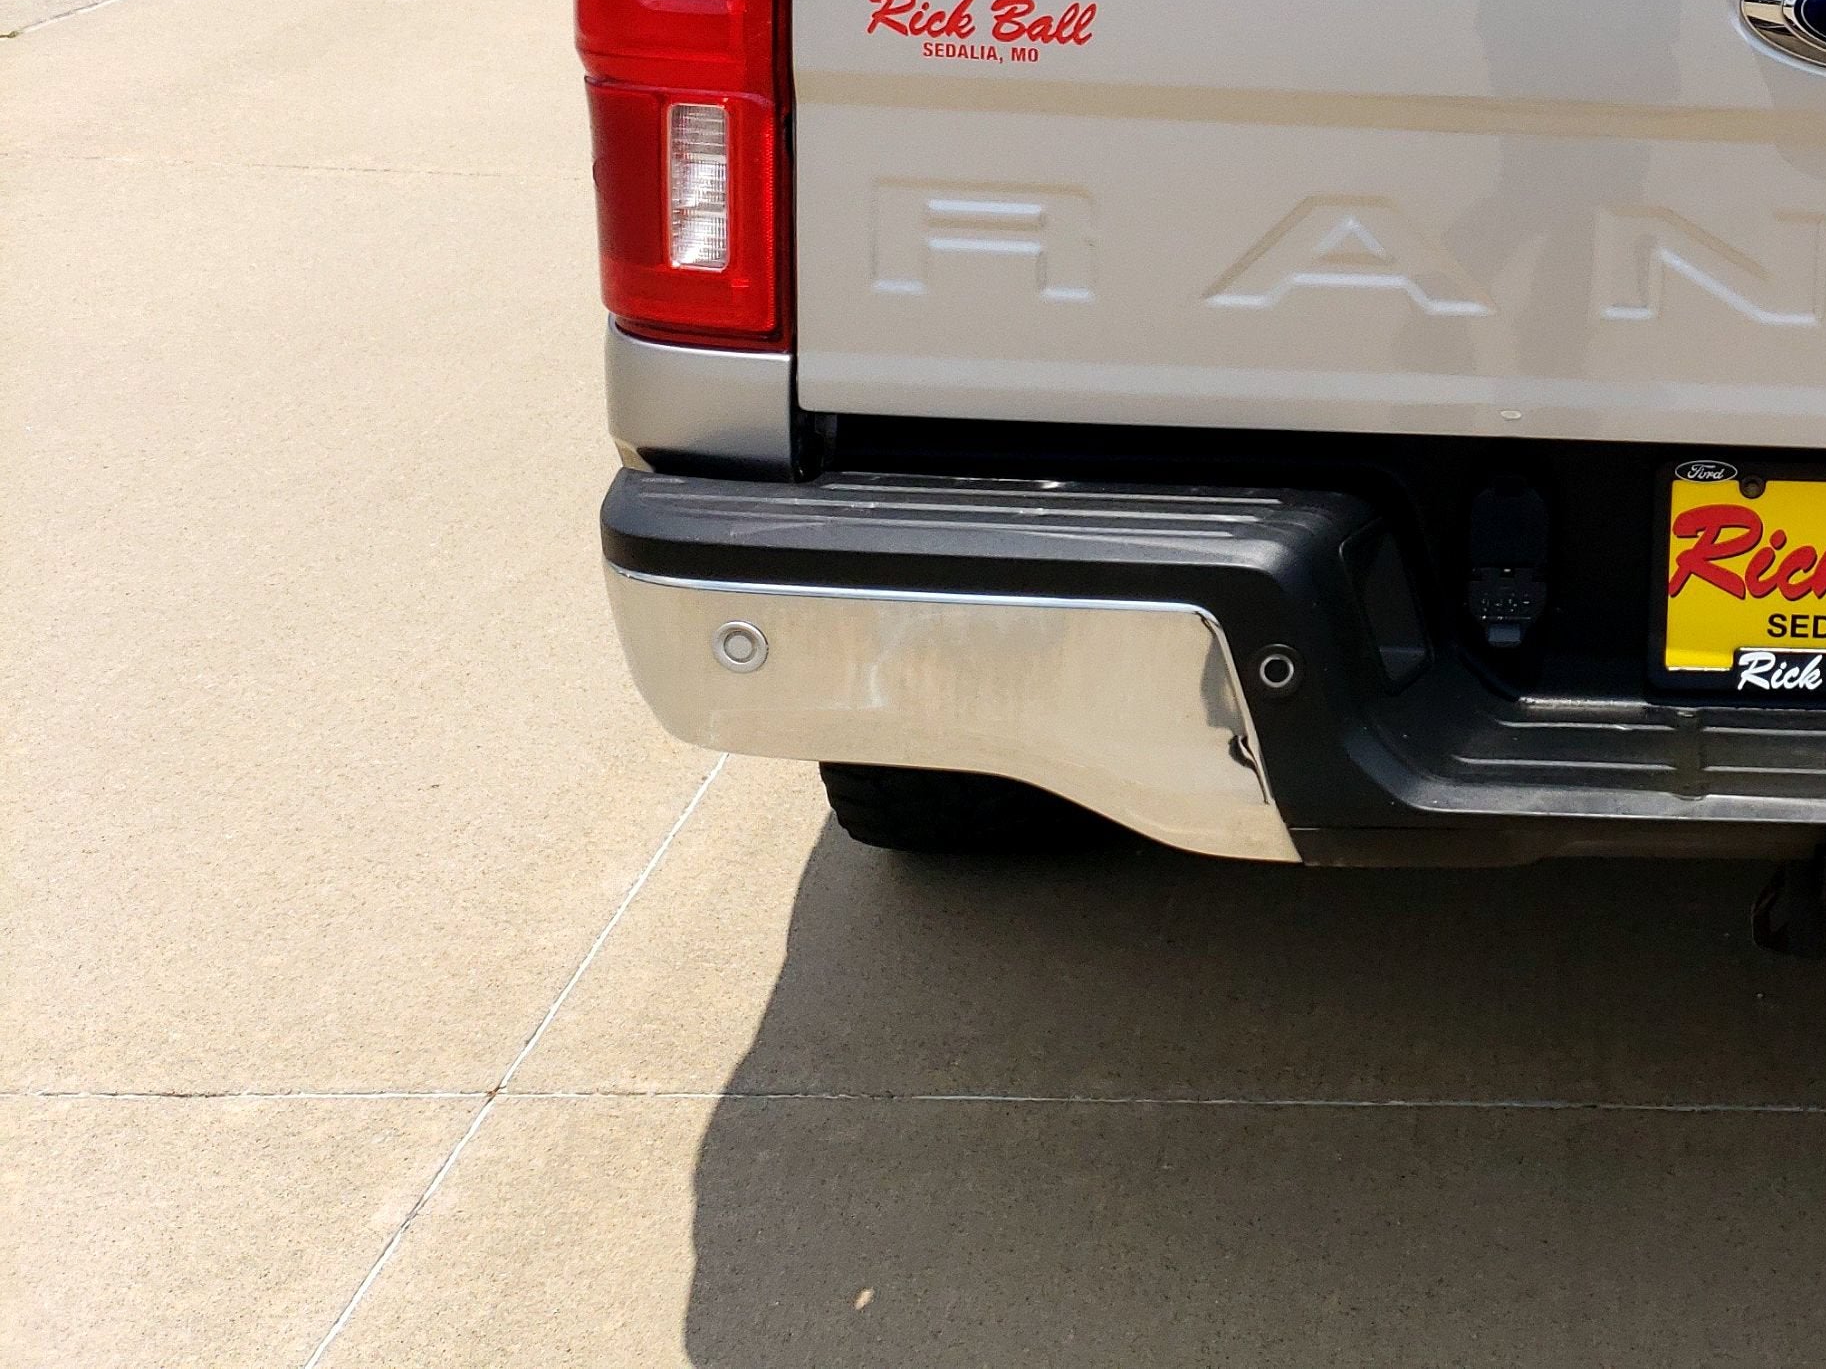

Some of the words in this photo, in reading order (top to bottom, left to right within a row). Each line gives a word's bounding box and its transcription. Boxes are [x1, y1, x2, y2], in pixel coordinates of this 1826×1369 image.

[922, 42, 1003, 64] SEDALIA,
[1011, 47, 1040, 63] MO
[1687, 464, 1725, 480] Ford
[1737, 652, 1823, 692] Rick
